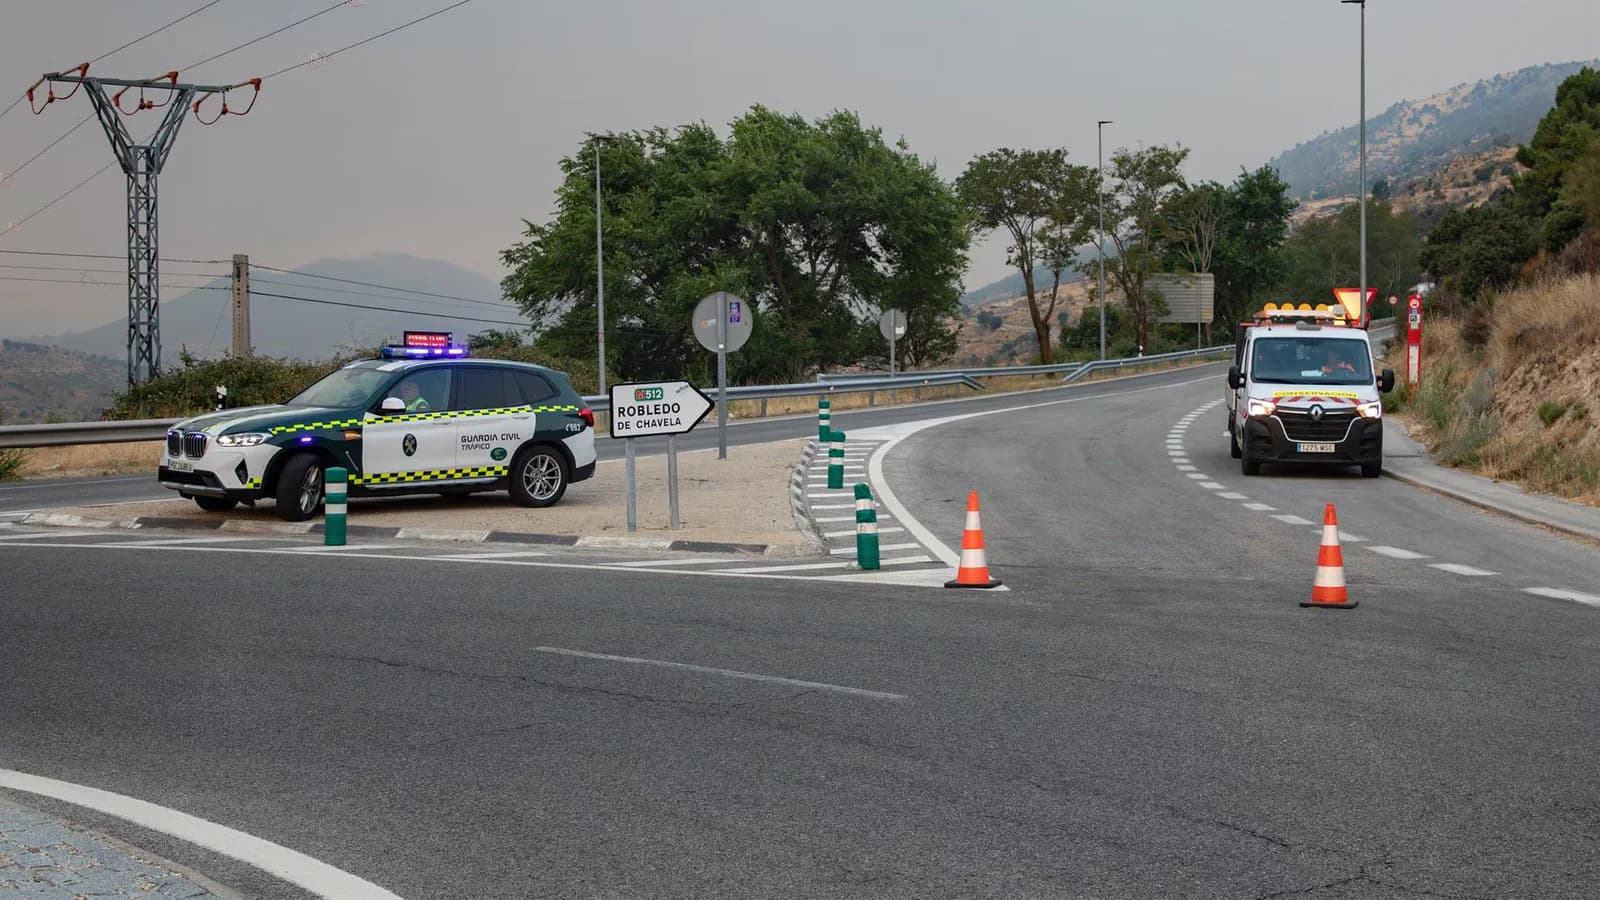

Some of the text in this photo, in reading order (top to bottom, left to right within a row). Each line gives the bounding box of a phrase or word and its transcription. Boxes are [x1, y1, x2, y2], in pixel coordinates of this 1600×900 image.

[618, 402, 680, 418] ROBLEDO
[617, 417, 682, 430] DE CHAVELA
[461, 433, 520, 443] GUARDIA CIVIL
